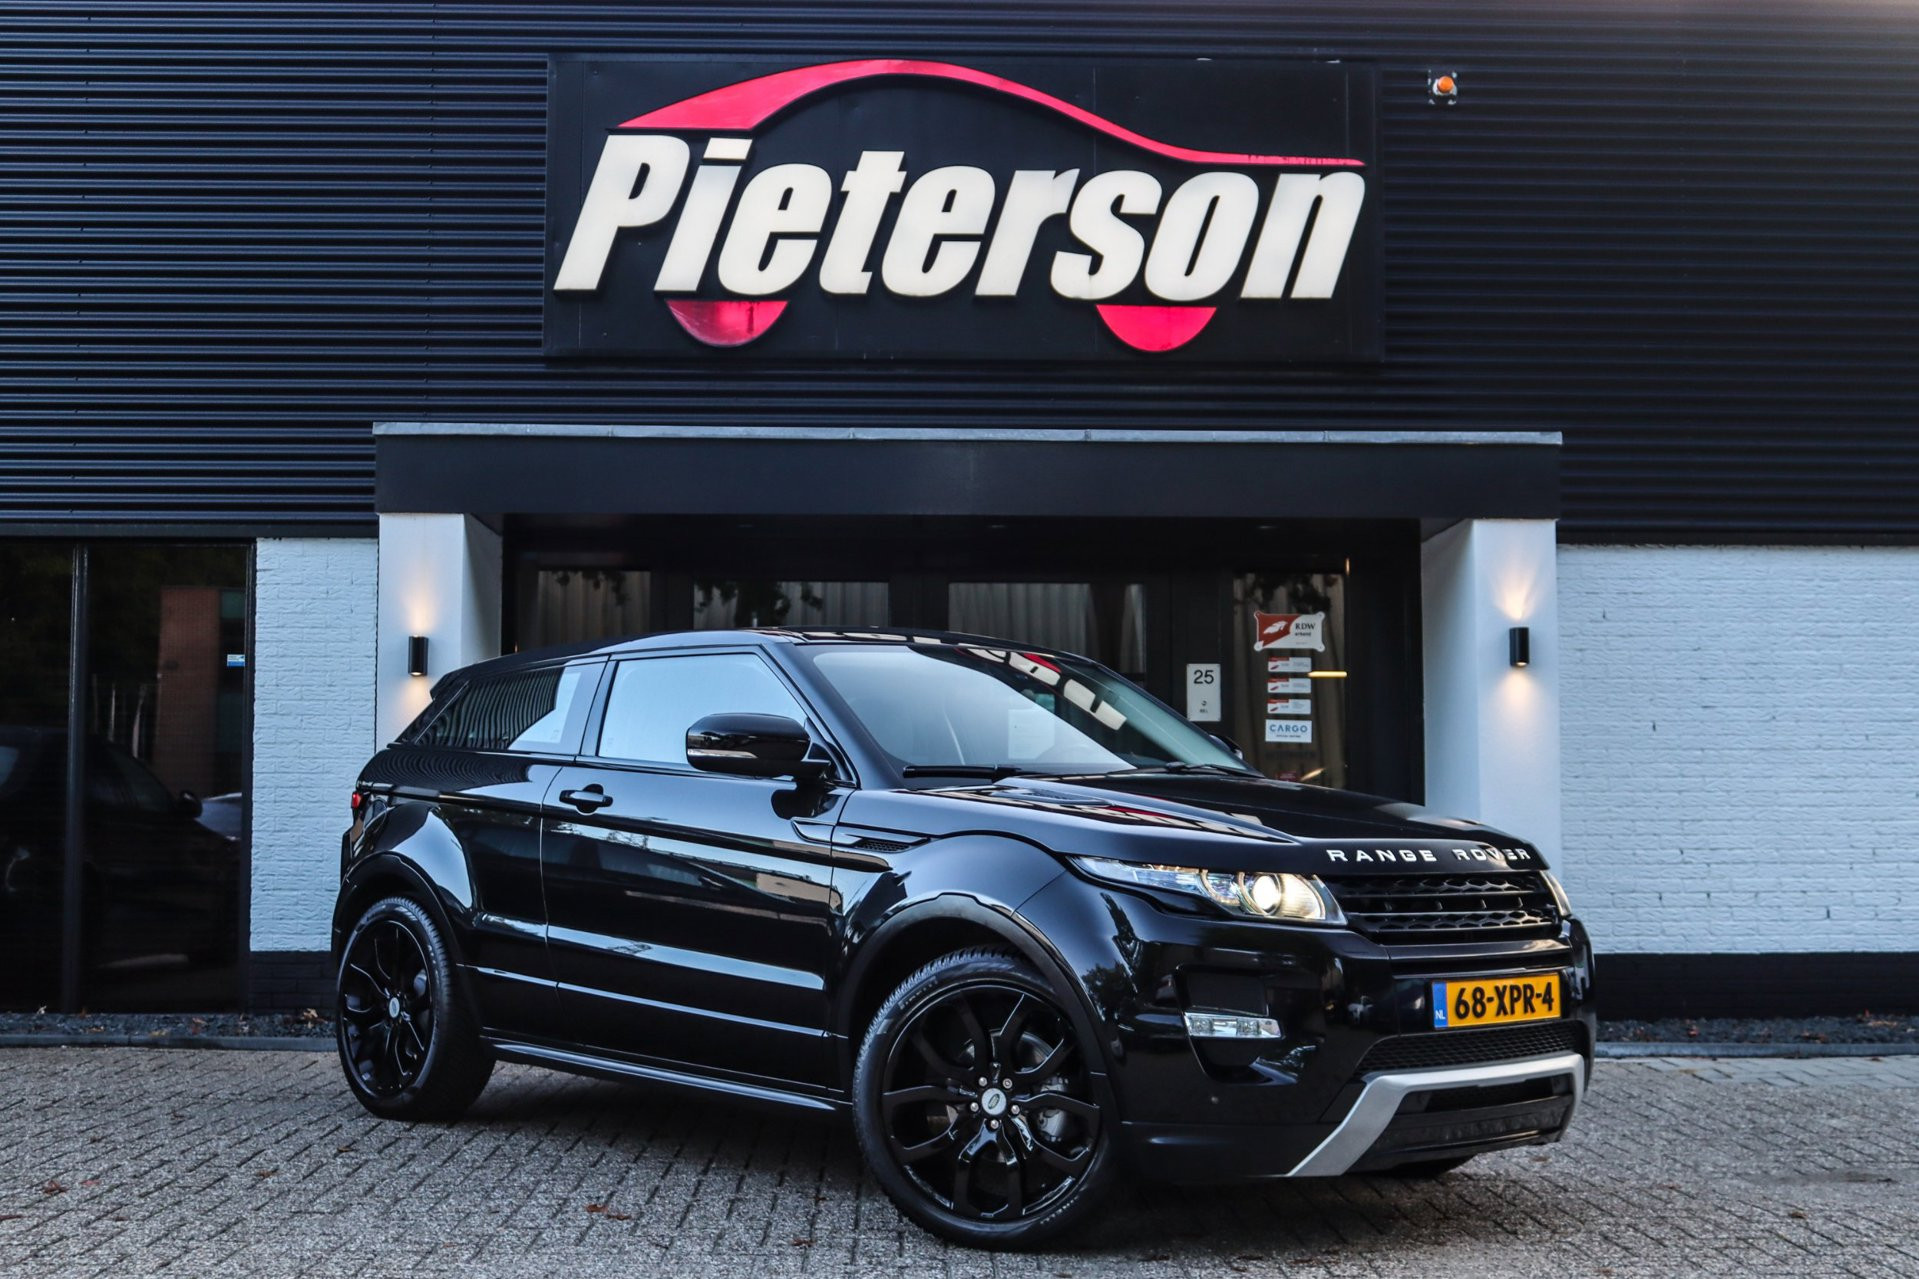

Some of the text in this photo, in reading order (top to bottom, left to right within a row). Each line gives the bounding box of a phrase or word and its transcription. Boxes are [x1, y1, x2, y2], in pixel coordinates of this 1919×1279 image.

[553, 132, 1366, 302] Pieterson
[1295, 622, 1316, 630] RDW
[1194, 669, 1214, 684] 25
[1270, 724, 1308, 733] CARGO
[1326, 848, 1531, 862] RANGE ROVER
[1454, 981, 1554, 1020] 68-XPR-4
[1435, 1010, 1446, 1020] NL
